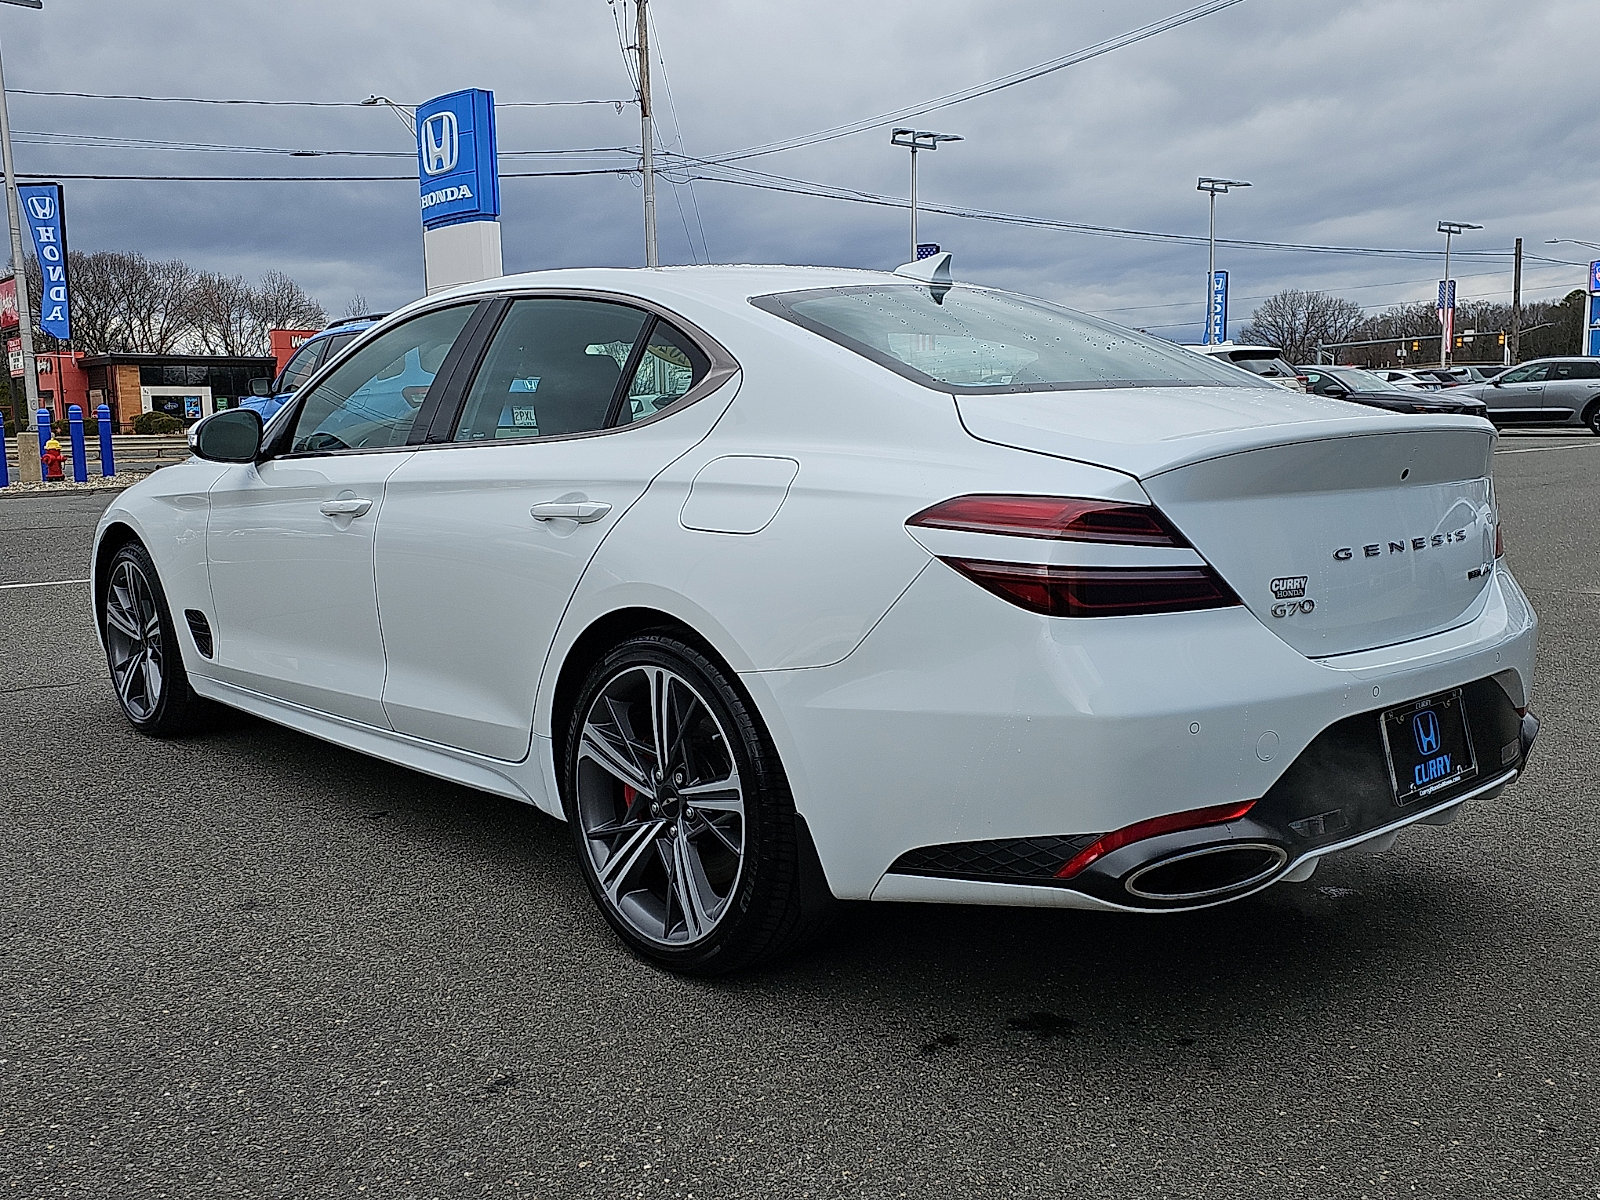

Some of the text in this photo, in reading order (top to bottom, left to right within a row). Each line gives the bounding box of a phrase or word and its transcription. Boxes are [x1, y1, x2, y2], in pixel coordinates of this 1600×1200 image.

[420, 184, 473, 209] HONDA
[1332, 529, 1467, 560] GENESIS
[1271, 577, 1307, 592] CURRY
[1276, 588, 1304, 598] HONDA
[1271, 600, 1315, 618] G70
[1414, 753, 1452, 785] CURRY
